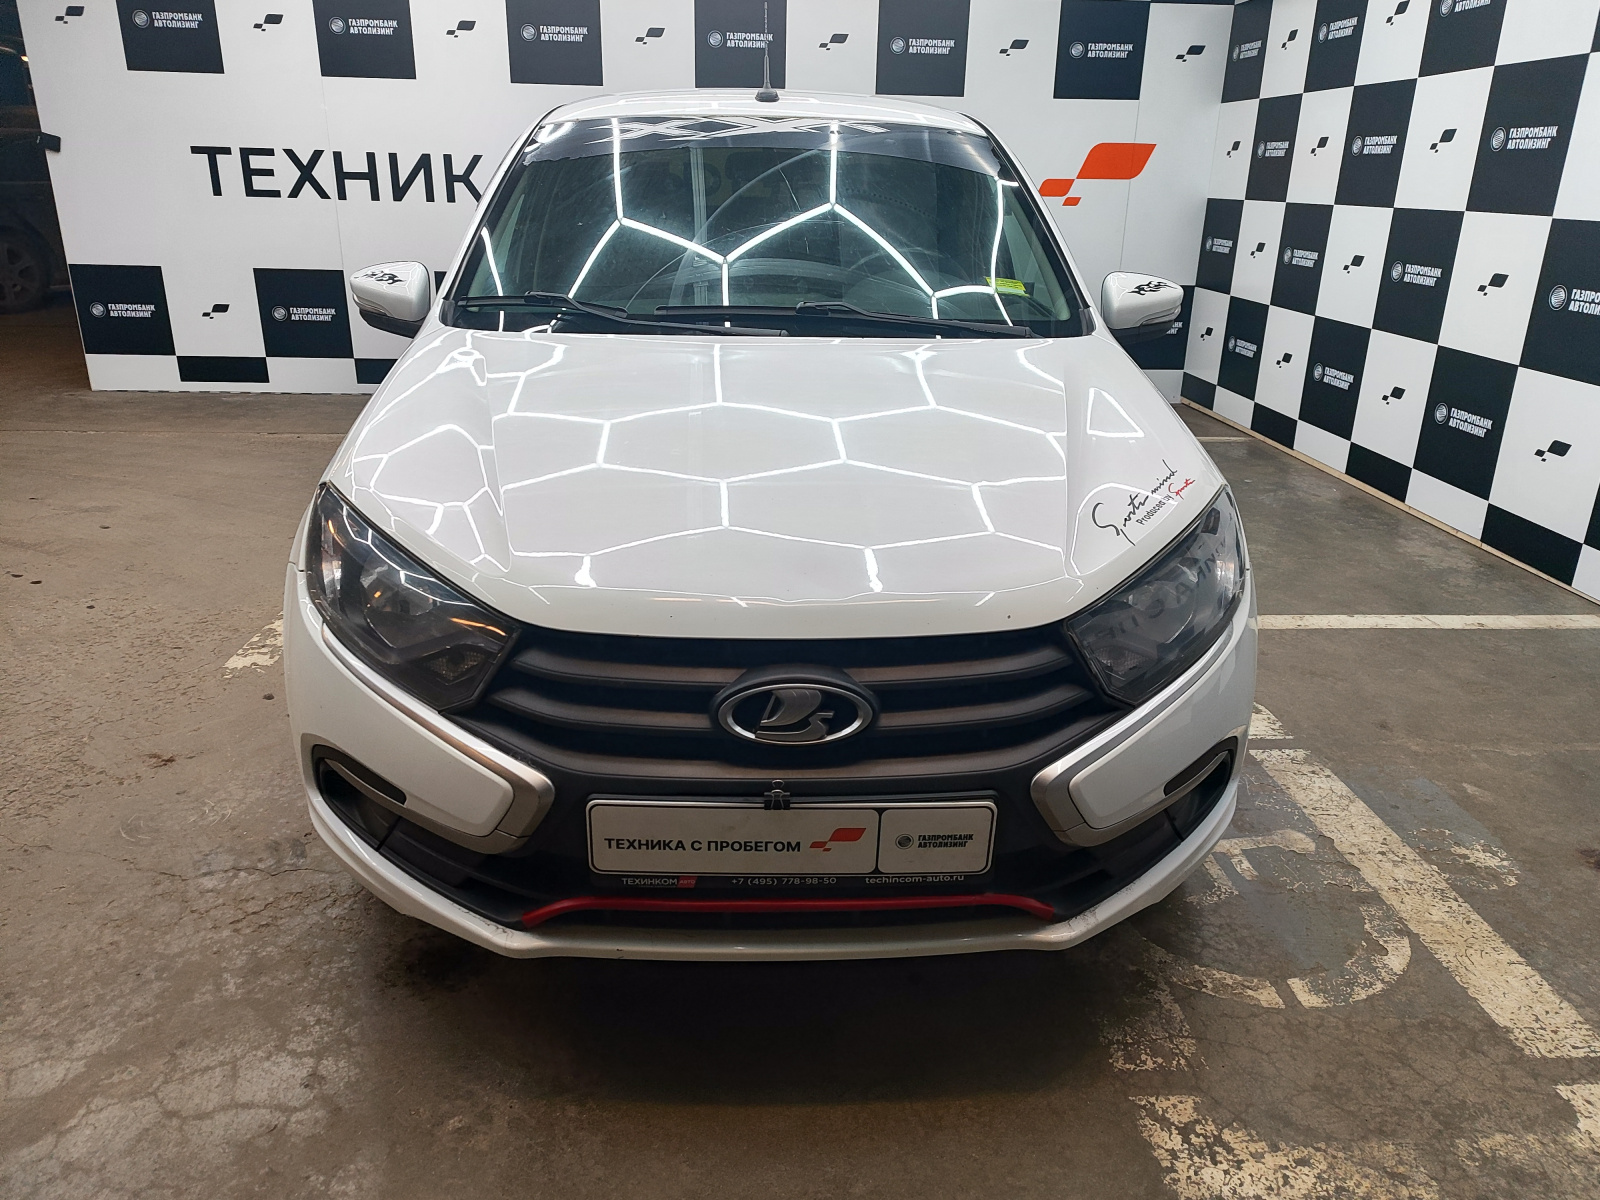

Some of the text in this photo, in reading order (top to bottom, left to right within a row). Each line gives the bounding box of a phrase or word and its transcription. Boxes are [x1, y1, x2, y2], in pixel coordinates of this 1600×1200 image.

[152, 12, 203, 21] ГАЗПРОМБАНК
[154, 20, 199, 28] АВТОЛИЗИНГ
[348, 19, 398, 27] ГАЗПРОМБАНК
[350, 27, 394, 35] АВТОЛИЗИНГ
[539, 26, 588, 34] ГАЗПРОМБАНК
[541, 34, 584, 42] АВТОЛИЗИНГ
[726, 32, 773, 41] ГАЗПРОМБАНК
[909, 39, 955, 47] ГАЗПРОМБАНК
[1088, 43, 1133, 51] ГАЗПРОМБАНК
[1509, 126, 1558, 138] ГАЗПРОМБАНК
[1507, 138, 1551, 150] АВТОЛИЗИНГ
[190, 145, 483, 203] ТЕХНИК
[1405, 264, 1442, 277] ГАЗПРОМБАНК
[1403, 274, 1437, 287] АВТОЛИЗИНГ
[1450, 408, 1493, 430] ГАЗПРОМБАНК
[1449, 417, 1487, 438] АВТОЛИЗИНГ
[1136, 500, 1167, 526] Produced
[604, 838, 801, 852] ТЕХНИКА С ПРОБЕГОМ
[747, 877, 778, 886] (495)
[865, 875, 964, 884] techincom-auto.ru
